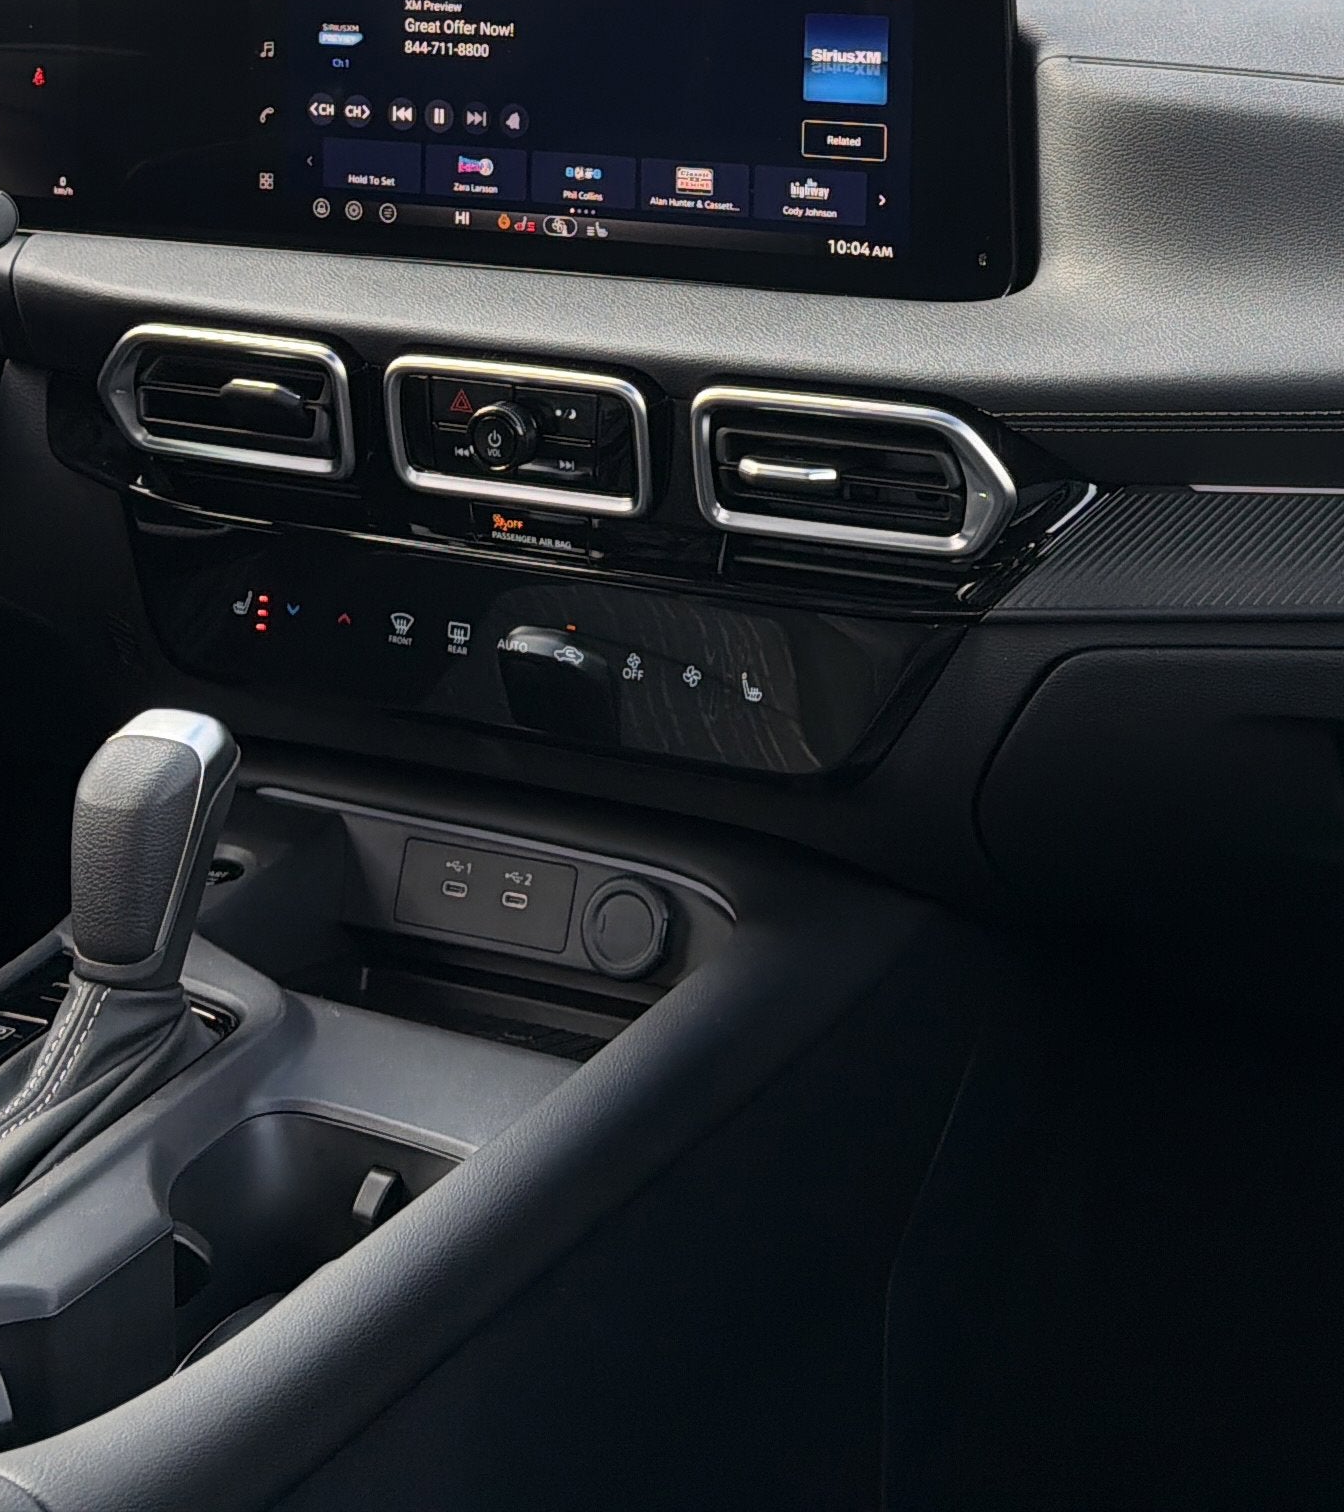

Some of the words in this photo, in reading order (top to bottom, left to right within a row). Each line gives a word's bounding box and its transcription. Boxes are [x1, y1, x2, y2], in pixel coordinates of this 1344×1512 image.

[405, 0, 421, 11] XM
[424, 0, 462, 13] Preview
[405, 19, 440, 34] Great
[444, 20, 477, 36] Offer
[480, 22, 514, 37] Now!
[405, 40, 489, 57] 844-711-8800
[811, 48, 881, 64] SiriusXM
[827, 135, 861, 147] Related
[348, 174, 366, 186] Hold
[369, 175, 379, 186] To
[381, 176, 395, 187] Set
[54, 186, 73, 196] km/h
[453, 183, 470, 192] Zara
[471, 184, 498, 194] Larsson
[791, 182, 829, 200] highway
[563, 191, 577, 199] Phil
[578, 192, 603, 201] Collins
[650, 197, 667, 205] Alan
[669, 198, 694, 209] Hunter
[696, 200, 703, 208] &
[455, 211, 469, 225] HI
[783, 206, 803, 217] Cody
[806, 208, 837, 218] Johnson
[828, 239, 870, 257] 10:04
[873, 245, 893, 258] AM
[488, 448, 501, 458] VOL
[492, 530, 537, 545] PASSENGER
[539, 537, 554, 547] AIR
[555, 540, 571, 549] BAG
[388, 635, 412, 646] FRONT
[497, 639, 528, 654] AUTO
[448, 645, 467, 655] REAR
[622, 668, 644, 681] OFF
[466, 863, 471, 875] 1
[524, 874, 532, 886] 2
